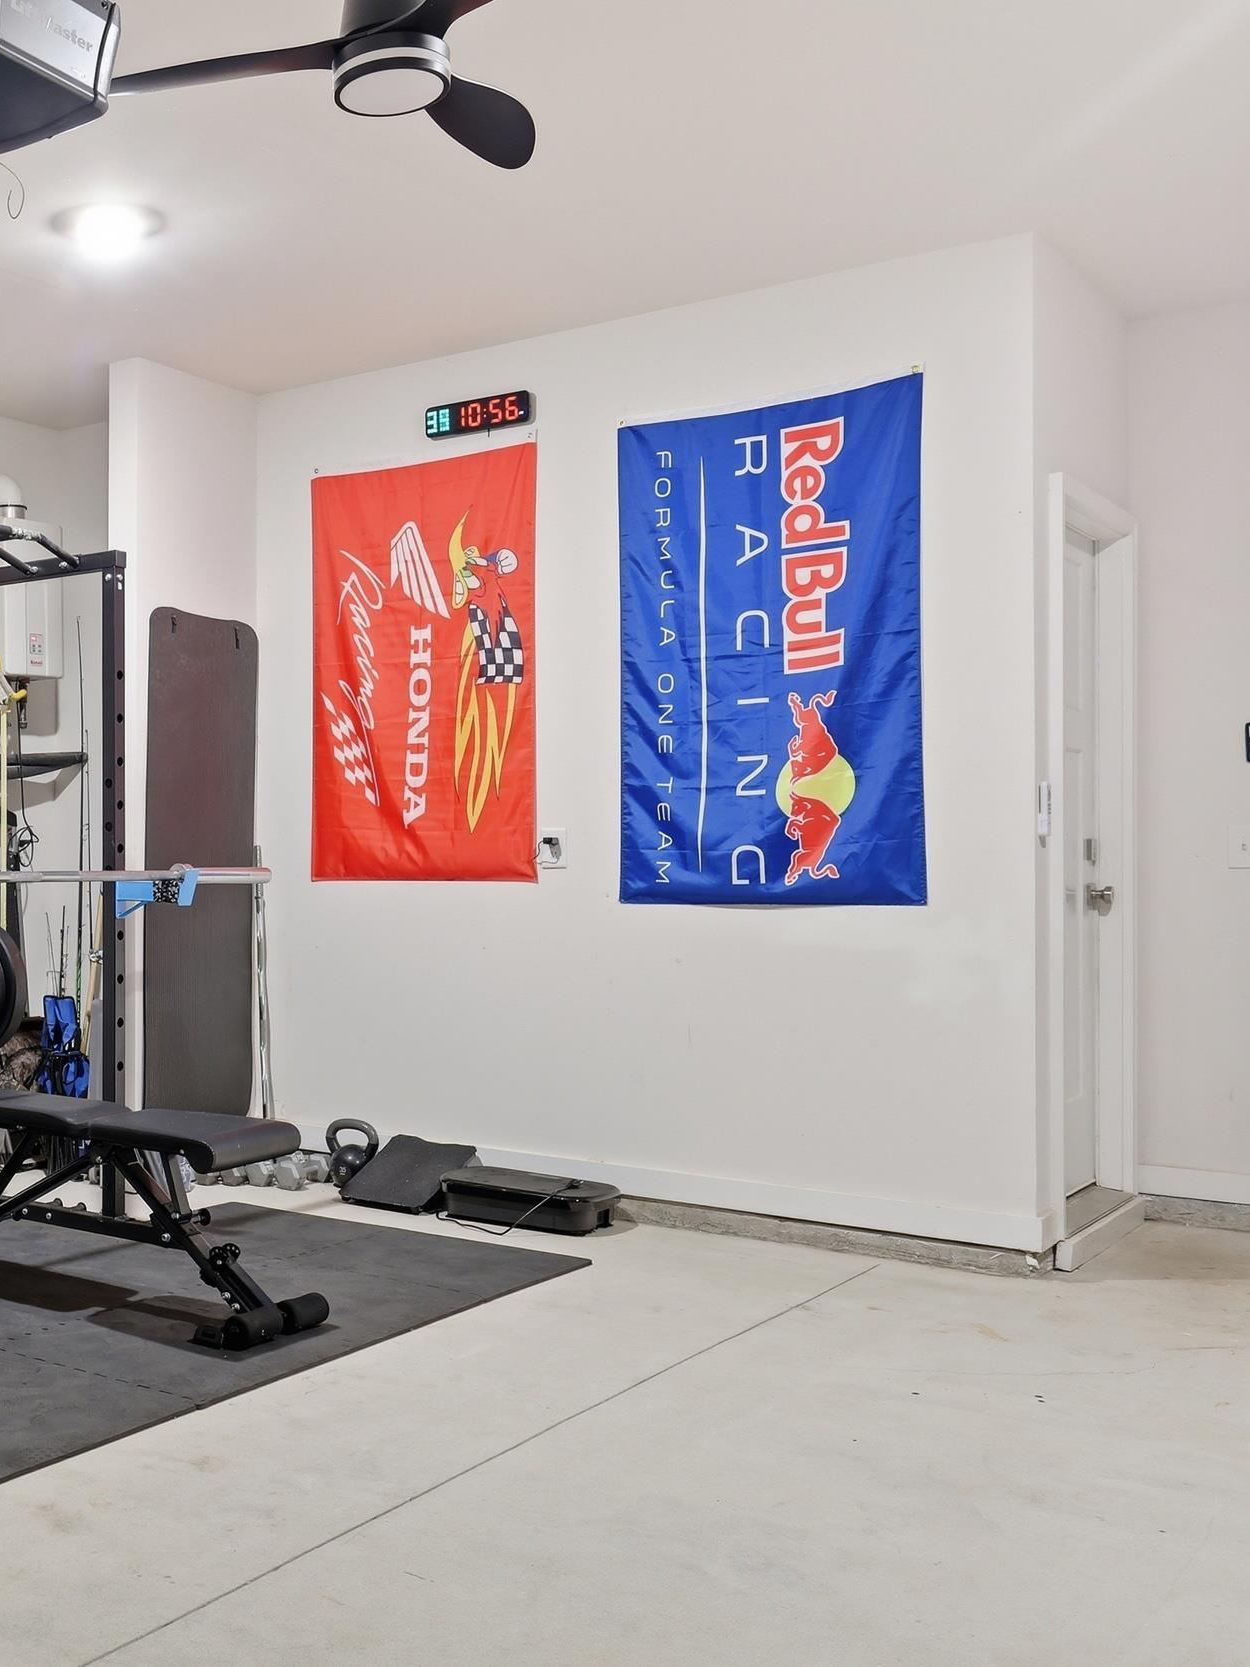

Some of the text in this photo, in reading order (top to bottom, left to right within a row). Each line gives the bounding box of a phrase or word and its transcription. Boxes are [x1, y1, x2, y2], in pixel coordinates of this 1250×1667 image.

[460, 396, 519, 427] 10:56
[336, 549, 386, 735] Racing
[403, 623, 432, 830] HONDA
[654, 450, 677, 885] FORMULA ONE TEAM
[731, 433, 770, 886] RACING
